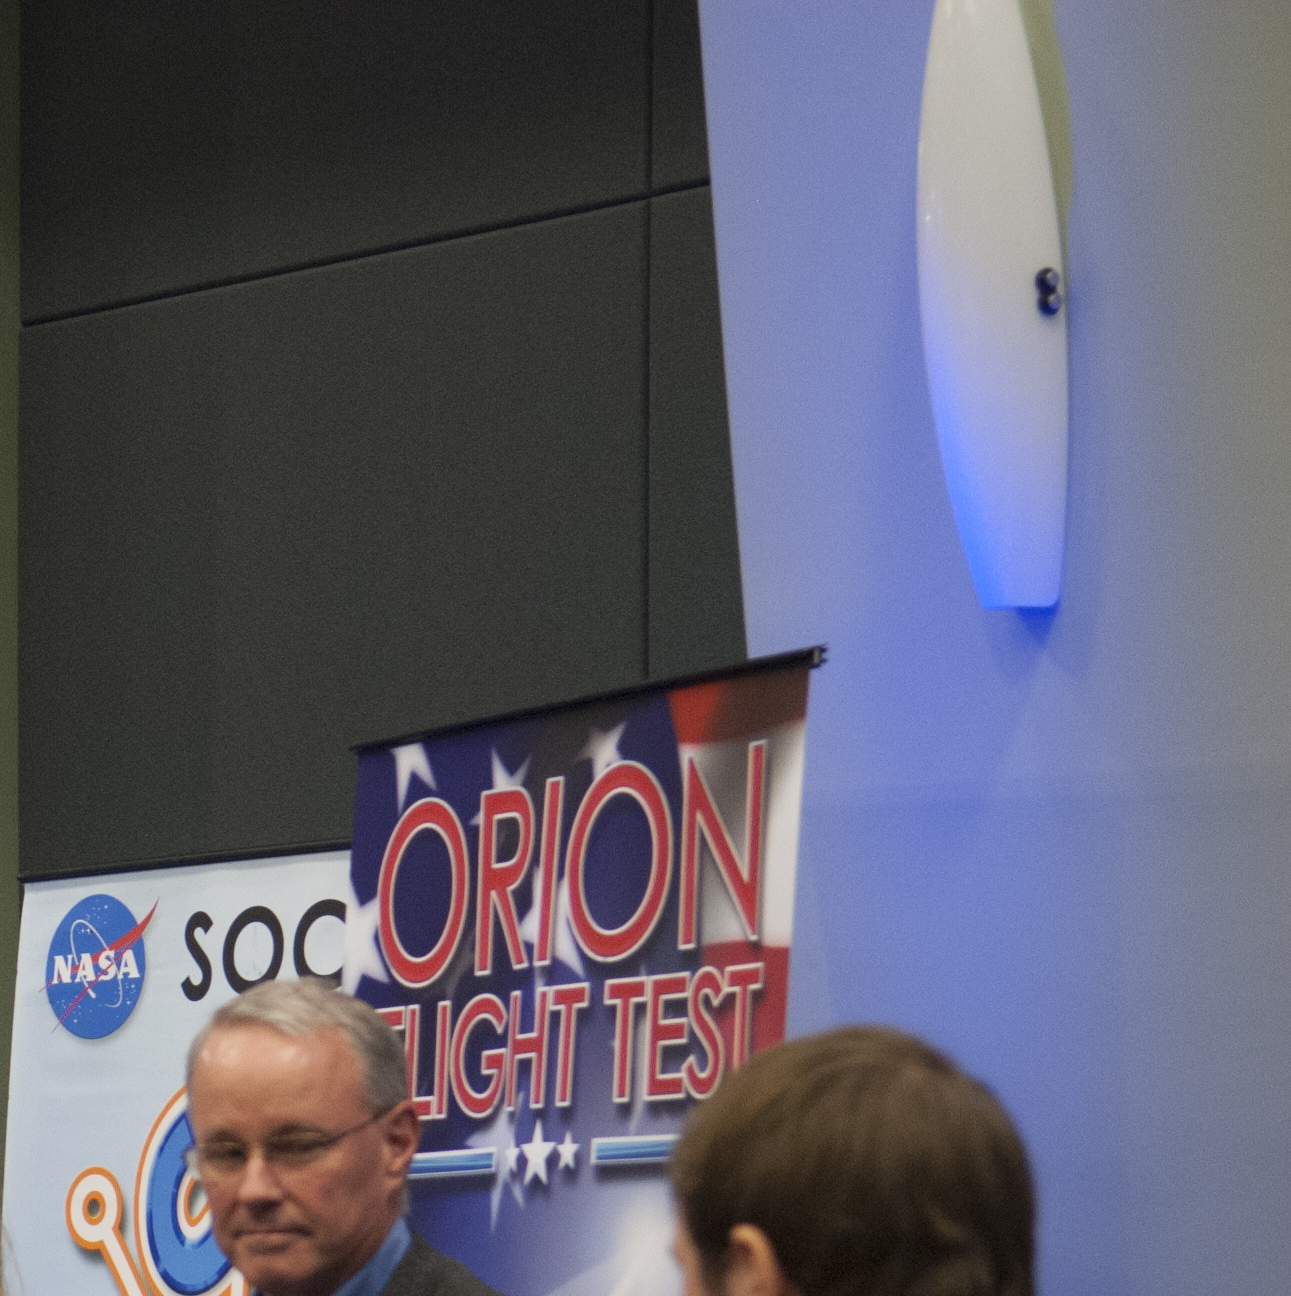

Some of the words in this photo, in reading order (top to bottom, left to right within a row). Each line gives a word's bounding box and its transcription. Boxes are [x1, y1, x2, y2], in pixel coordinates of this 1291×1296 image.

[378, 739, 768, 989] ORION
[51, 948, 141, 985] NASA
[375, 981, 590, 1122] LIGHT
[603, 962, 765, 1102] TEST
